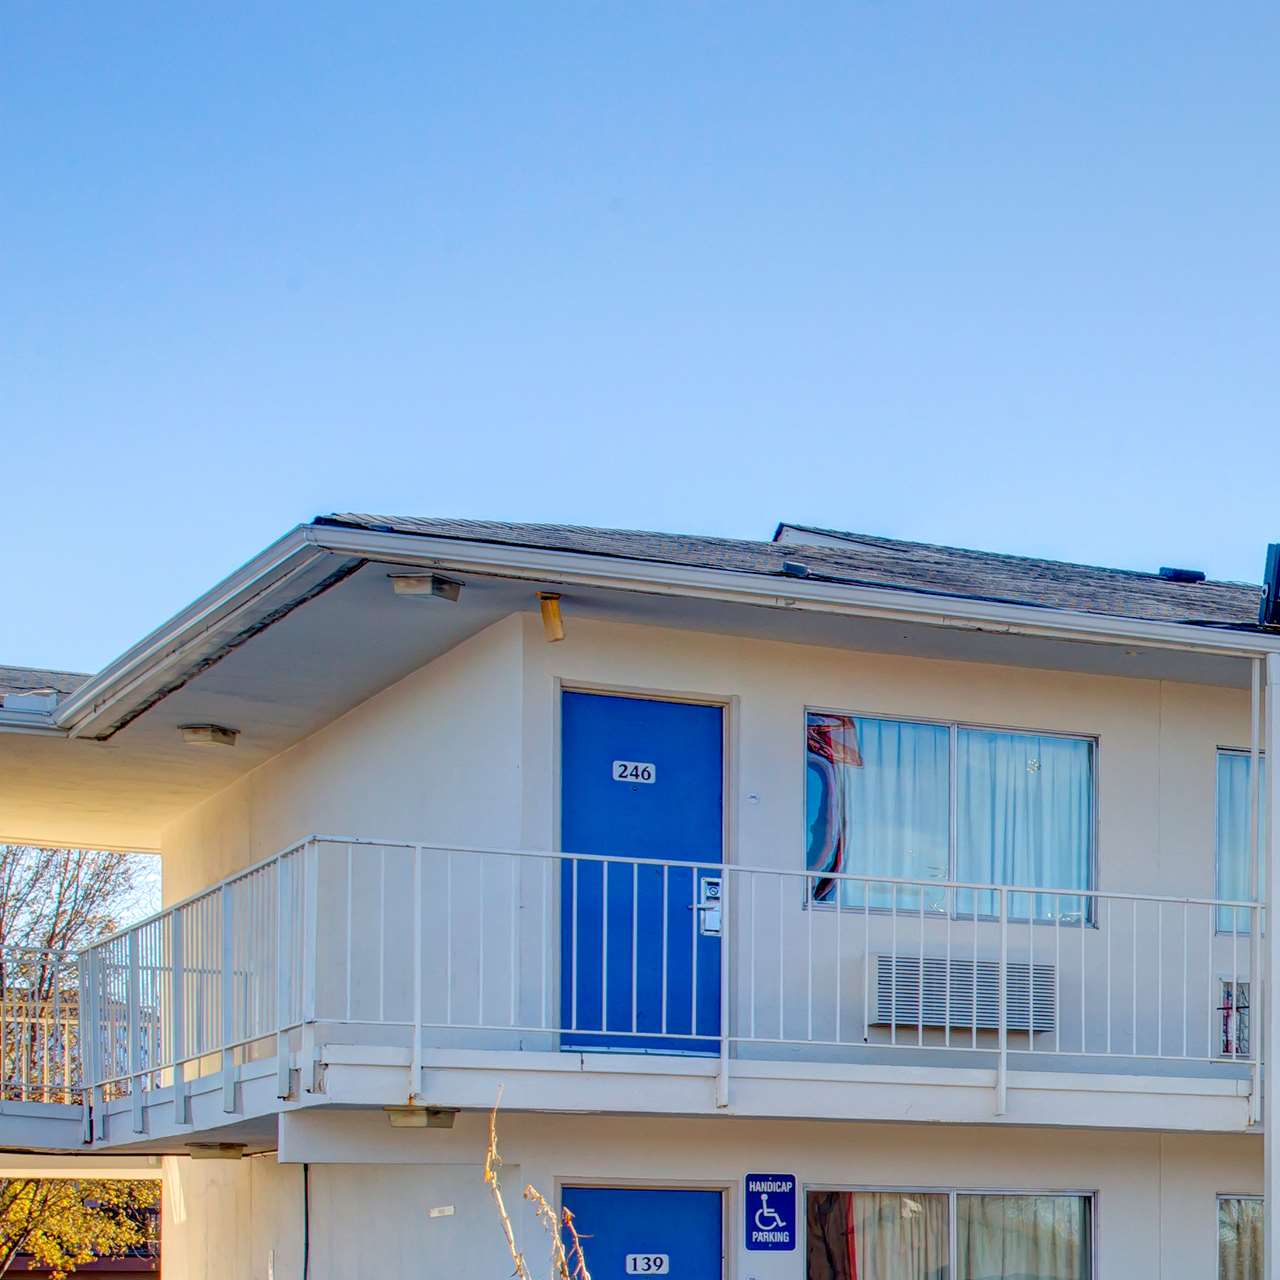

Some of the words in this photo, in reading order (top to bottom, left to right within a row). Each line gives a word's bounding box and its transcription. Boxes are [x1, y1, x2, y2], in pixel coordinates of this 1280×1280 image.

[618, 763, 651, 781] 246
[749, 1181, 793, 1193] HANDICAP
[752, 1231, 790, 1243] PARKING
[631, 1256, 664, 1272] 139
